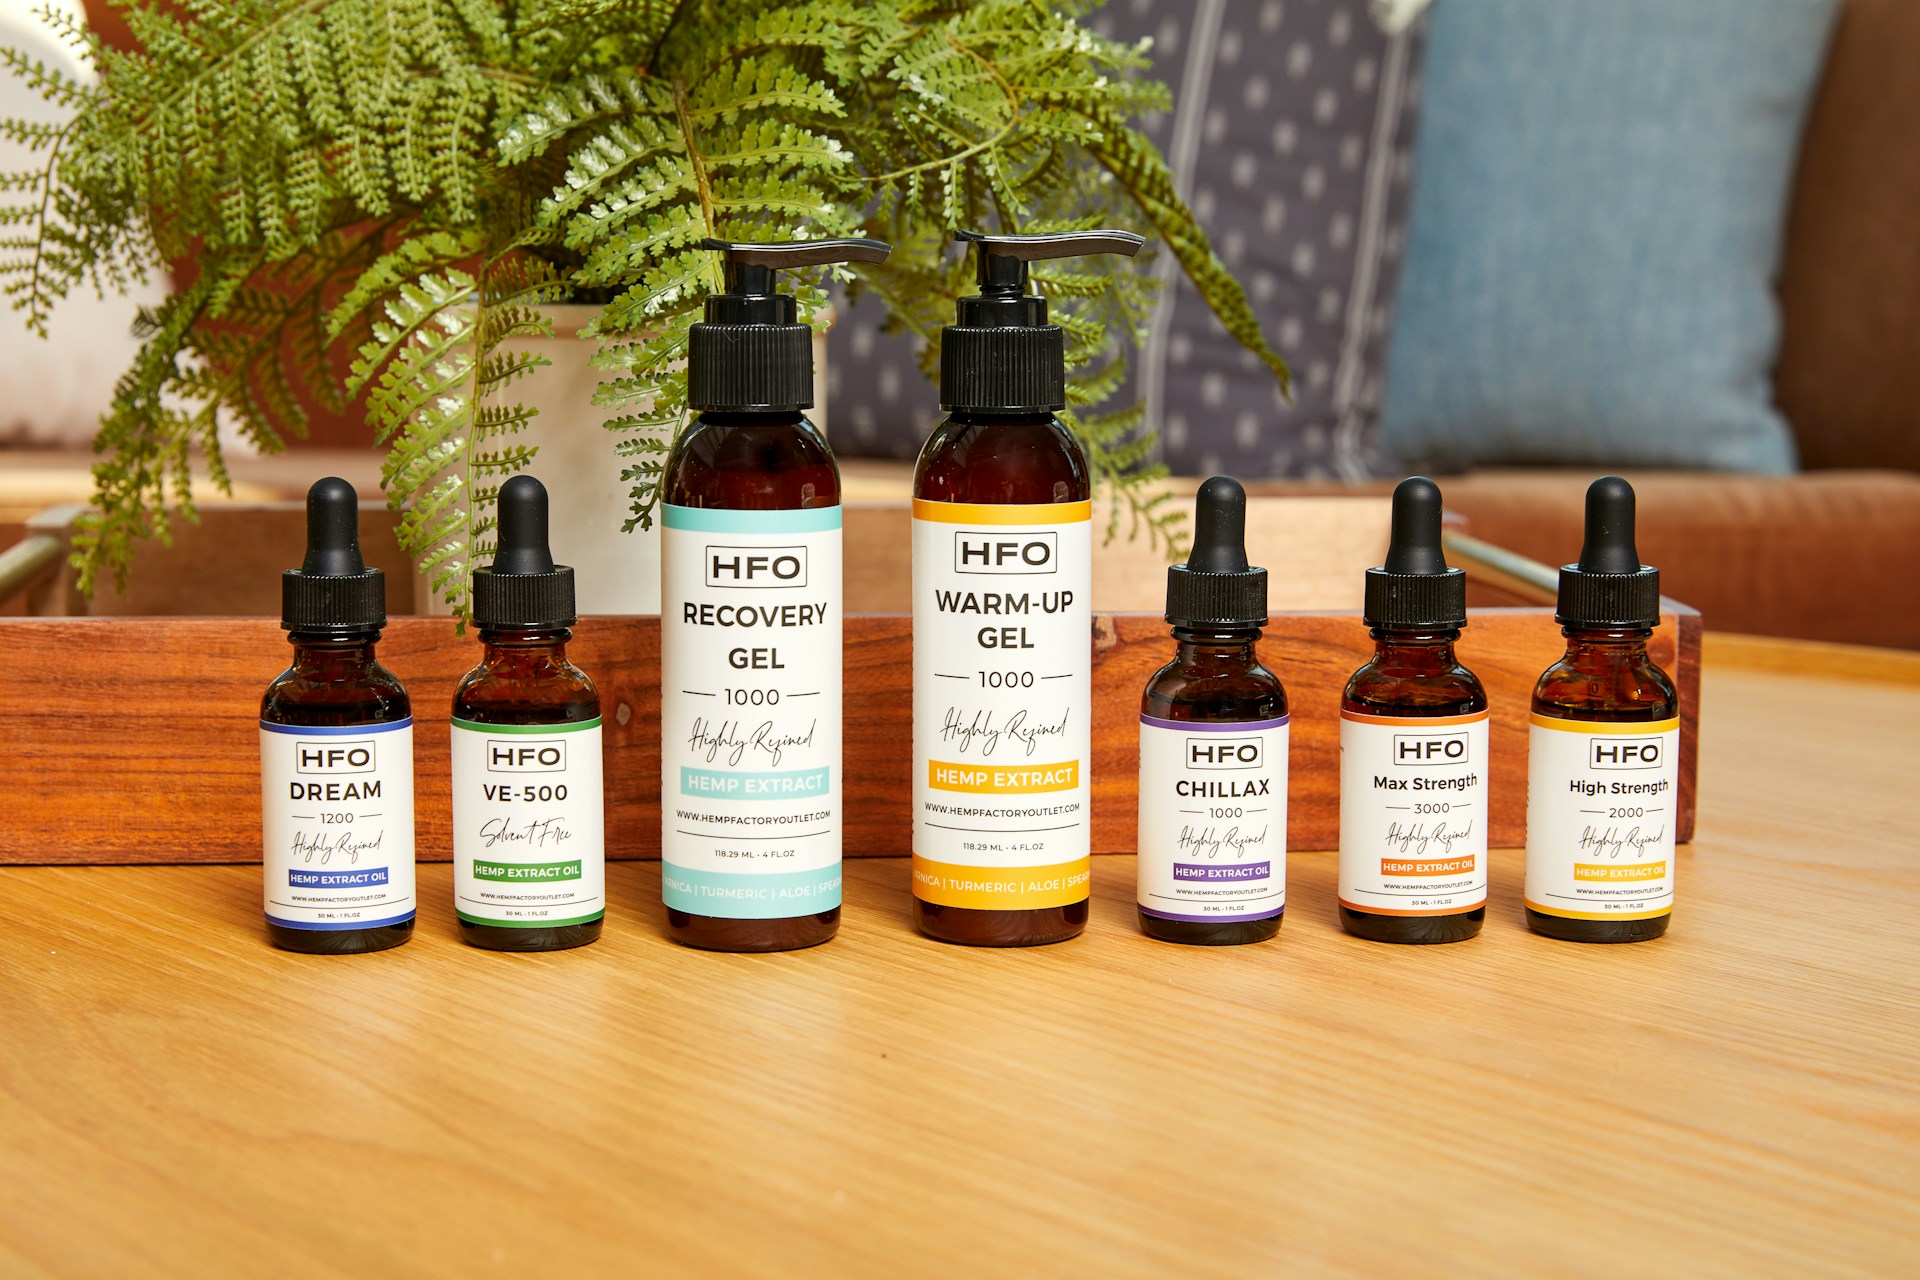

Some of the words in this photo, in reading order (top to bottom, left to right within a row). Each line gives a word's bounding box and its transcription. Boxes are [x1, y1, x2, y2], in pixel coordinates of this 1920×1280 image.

[962, 541, 1050, 566] HFO
[713, 555, 801, 580] HFO
[935, 589, 1073, 615] WARM-UP
[684, 602, 827, 628] RECOVERY
[978, 627, 1034, 649] GEL
[728, 648, 785, 669] GEL
[978, 671, 1034, 688] 1000
[724, 688, 780, 706] 1000
[940, 707, 1003, 756] Highly
[1004, 707, 1070, 757] Refined
[688, 717, 749, 767] Highly
[750, 718, 816, 767] Refined
[1400, 739, 1464, 759] HFO
[302, 748, 370, 768] HFO
[493, 747, 561, 766] HFO
[1192, 744, 1258, 763] HFO
[1596, 745, 1659, 763] HFO
[688, 774, 739, 793] HEMP
[745, 774, 823, 793] EXTRACT
[936, 768, 988, 786] HEMP
[994, 768, 1073, 787] EXTRACT
[1374, 775, 1408, 790] Max
[1412, 772, 1478, 791] Strength
[290, 780, 381, 801] DREAM
[483, 784, 567, 802] VE-500
[1176, 778, 1270, 798] CHILLAX
[1570, 780, 1606, 796] High
[1611, 779, 1669, 796] Strength
[676, 809, 831, 825] WWW.HEMPFACTORYOUTLET.COM
[924, 801, 1080, 818] WWW.HEMPFACTORYOUTLET.COM
[1209, 807, 1243, 819] 1000
[1414, 802, 1450, 815] 3000
[1609, 807, 1643, 819] 2000
[321, 813, 354, 824] 1200
[479, 817, 540, 848] Solvent
[538, 817, 572, 847] Free
[1177, 825, 1222, 858] Highly
[1223, 824, 1268, 858] Refined
[1385, 822, 1430, 854] Highly
[1431, 819, 1473, 853] Refined
[1578, 825, 1624, 858] Highly
[1624, 824, 1665, 857] Refined
[291, 831, 336, 865] Highly
[336, 829, 384, 864] Refined
[715, 850, 739, 858] 118.29
[963, 842, 988, 851] 118.29
[990, 844, 1003, 852] ML
[475, 865, 505, 876] HEMP
[507, 867, 561, 878] EXTRACT
[563, 865, 579, 875] OIL
[1176, 867, 1205, 877] HEMP
[1208, 868, 1253, 878] EXTRACT
[1255, 866, 1269, 876] OIL
[1383, 863, 1414, 872] HEMP
[1416, 862, 1460, 872] EXTRACT
[1462, 860, 1474, 870] OIL
[1576, 868, 1607, 877] HEMP
[1610, 867, 1652, 878] EXTRACT
[1654, 865, 1664, 874] OIL
[290, 873, 317, 884] HEMP
[321, 874, 368, 884] EXTRACT
[371, 872, 387, 882] OIL
[949, 879, 1016, 893] TURMERIC
[1028, 879, 1059, 891] ALOE
[1383, 880, 1473, 890] WWW.HEMPFACTORYOUTLET.COM
[291, 893, 386, 903] WWW.HEMPFACTORYOUTLET.COM
[480, 892, 574, 901] WWW.HEMPFACTORYOUTLET.COM
[701, 886, 767, 899] TURMERIC
[779, 885, 810, 898] ALOE
[1176, 886, 1268, 896] WWW.HEMPFACTORYOUTLET.COM
[1576, 886, 1663, 895] WWW.HEMPFACTORYOUTLET.COM
